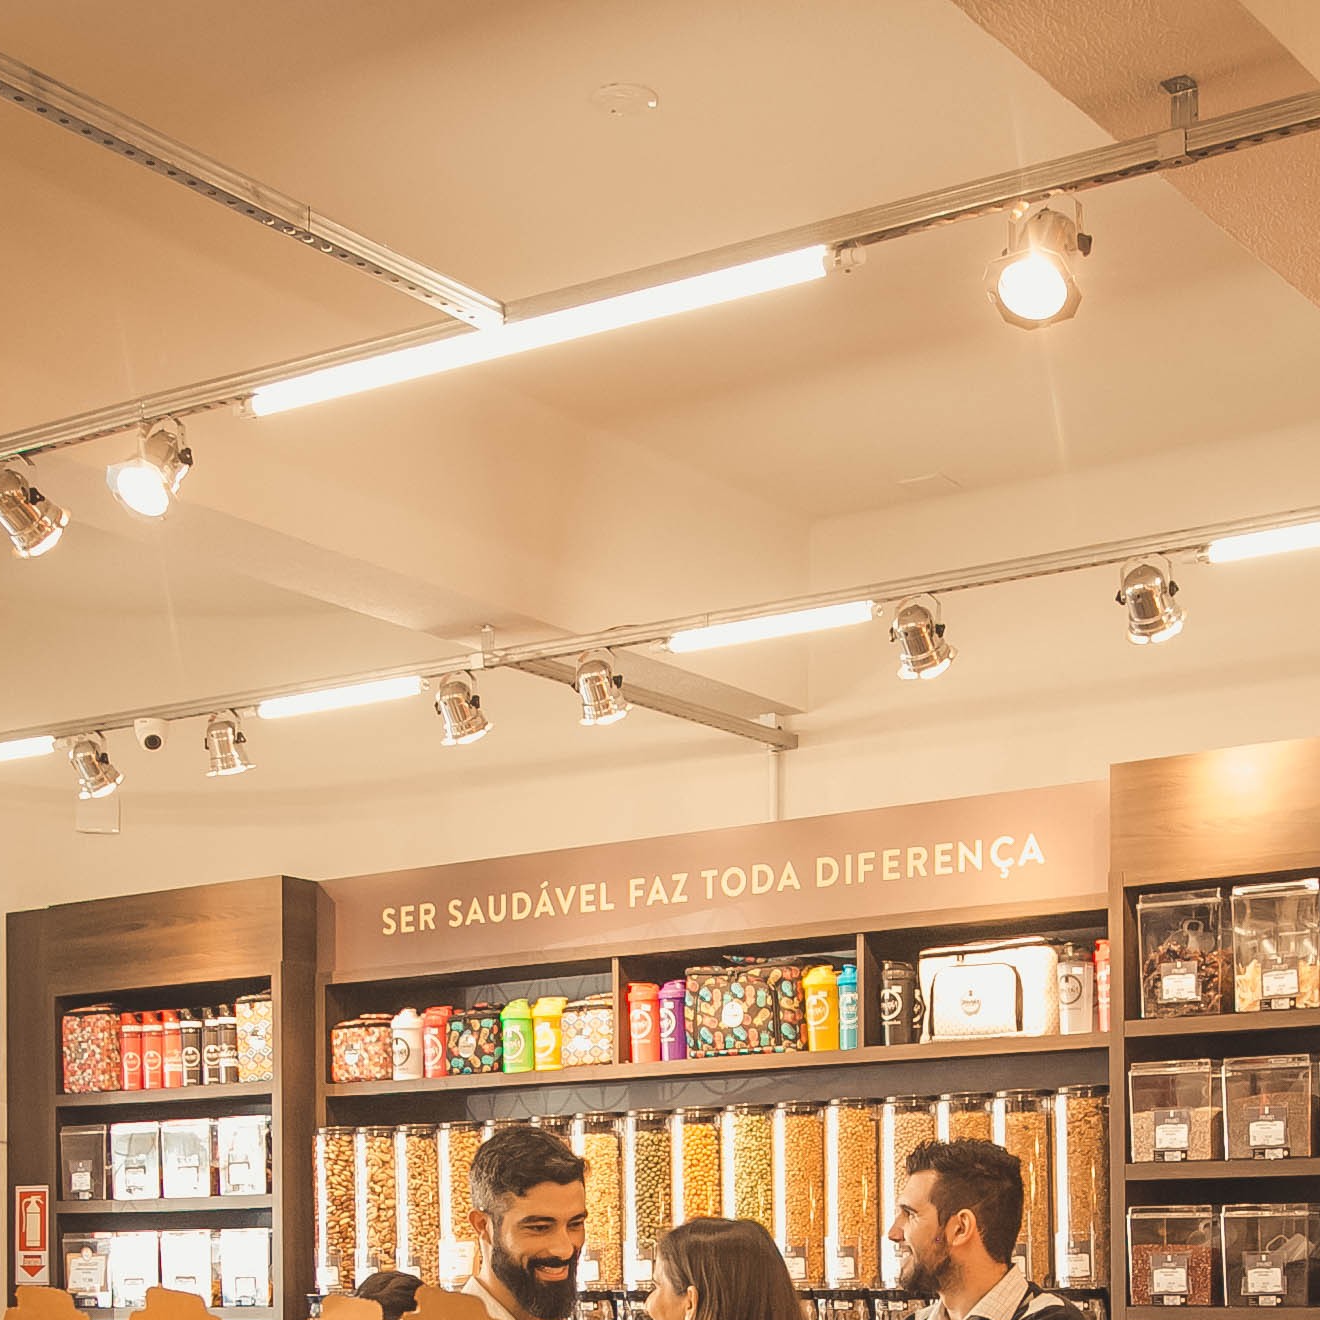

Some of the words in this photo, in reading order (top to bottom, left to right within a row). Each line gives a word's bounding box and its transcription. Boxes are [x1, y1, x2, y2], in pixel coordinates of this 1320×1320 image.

[382, 899, 437, 936] SER
[448, 880, 614, 928] SAUDÁVEL
[629, 872, 688, 908] FAZ
[700, 861, 802, 899] TODA
[816, 832, 1046, 889] DIFERENÇA
